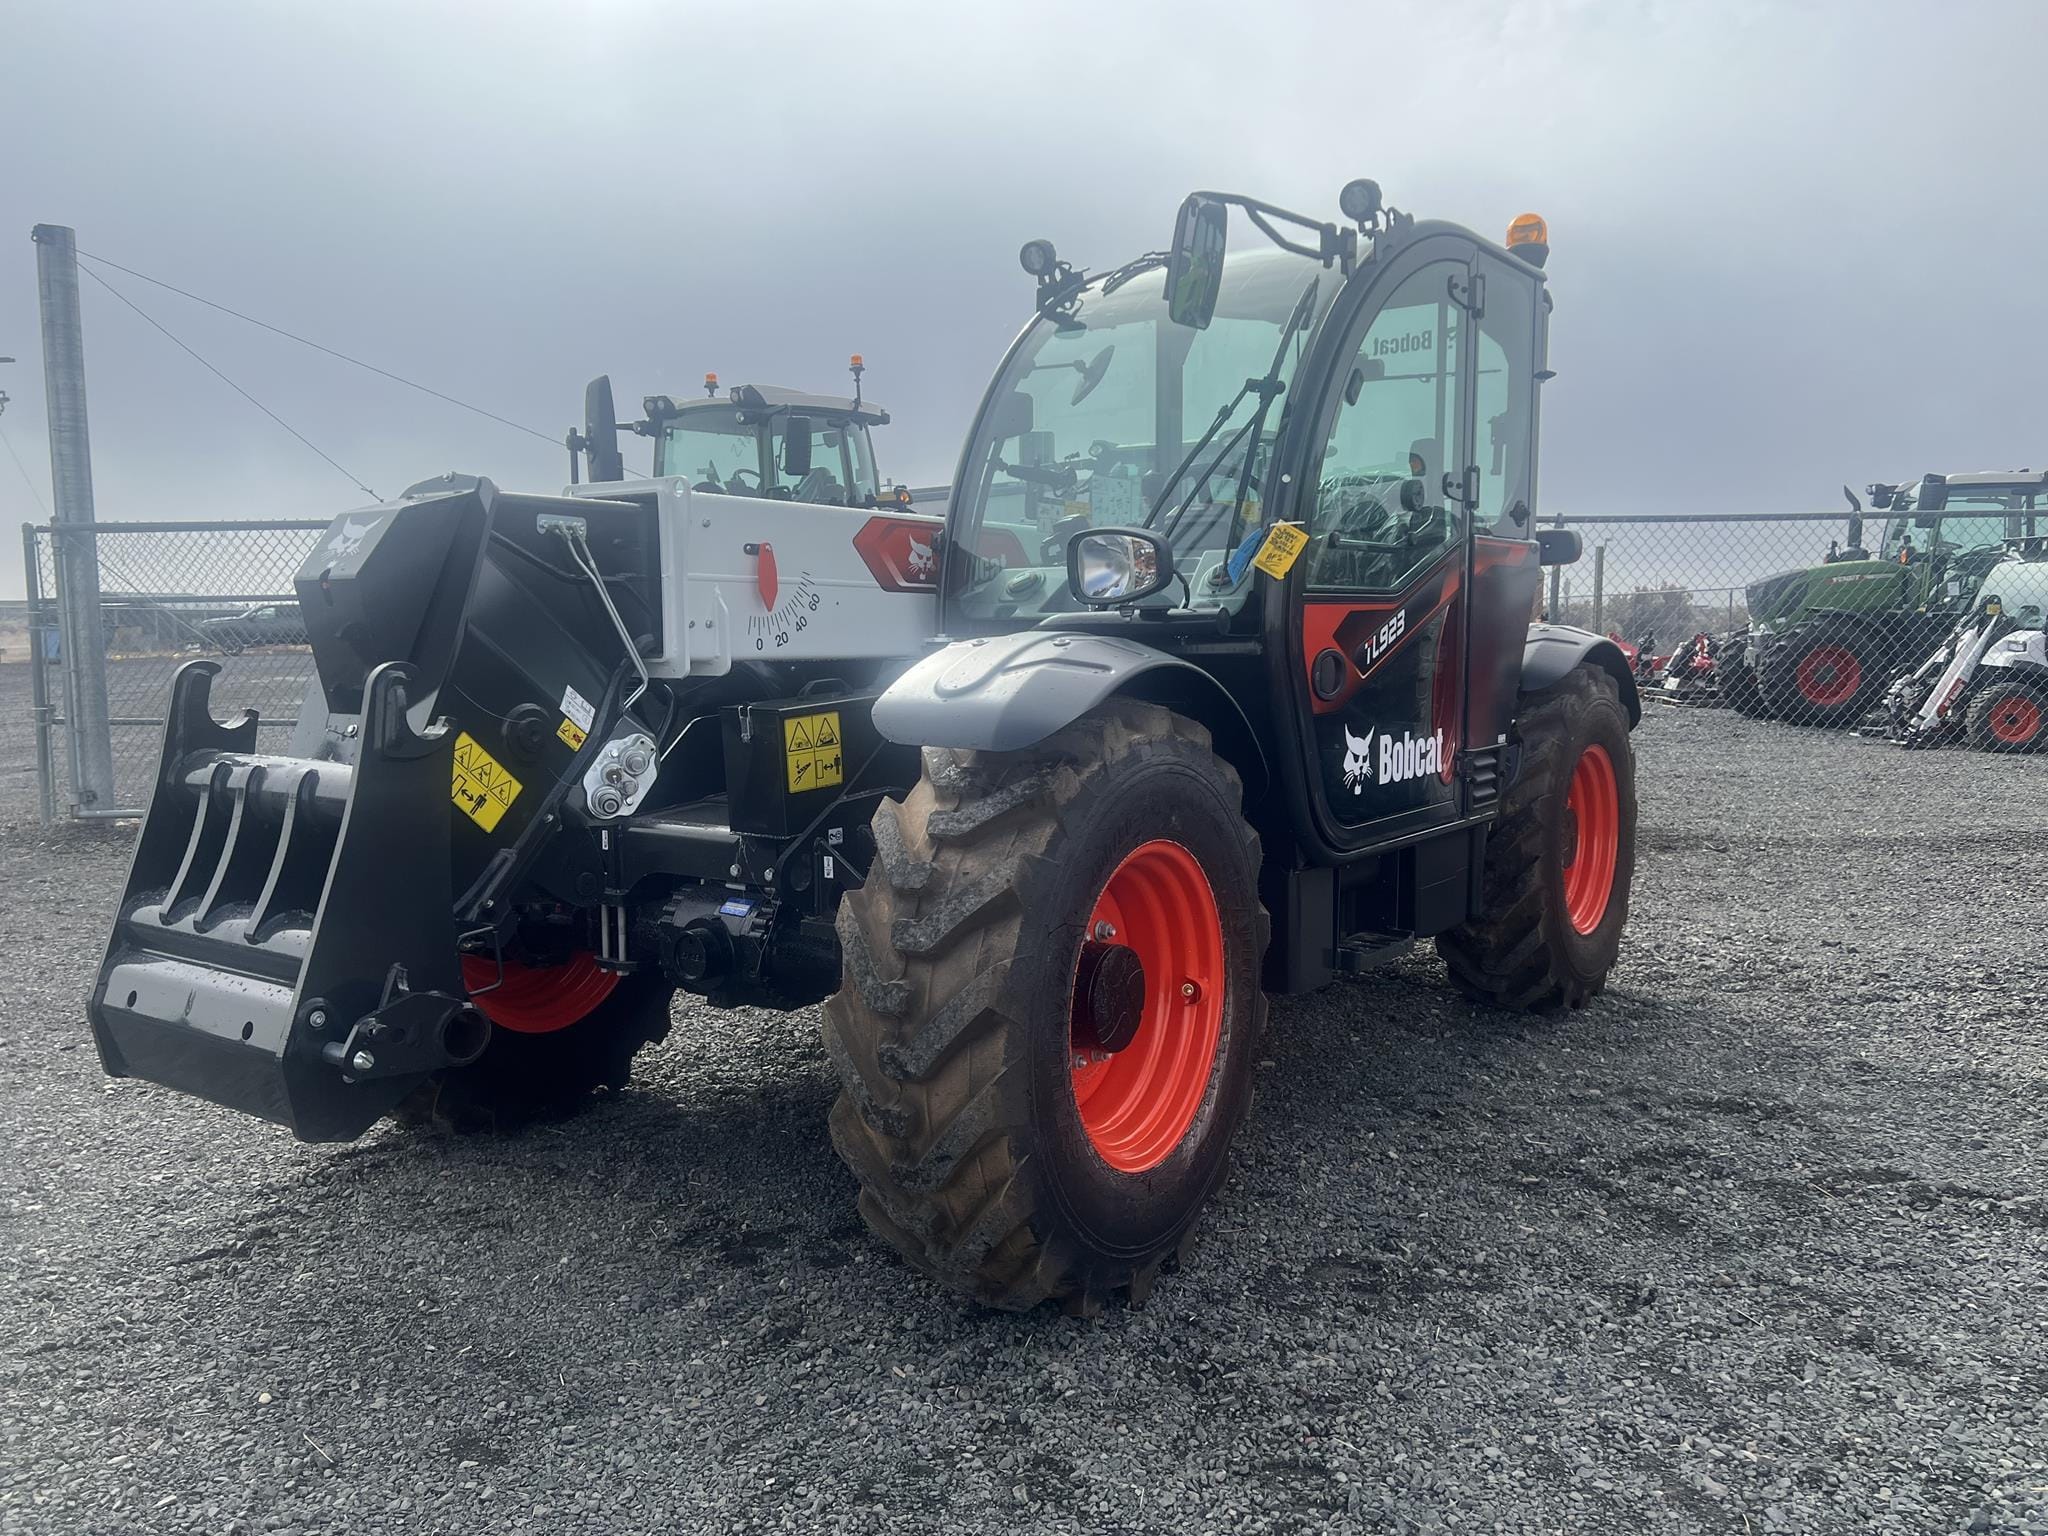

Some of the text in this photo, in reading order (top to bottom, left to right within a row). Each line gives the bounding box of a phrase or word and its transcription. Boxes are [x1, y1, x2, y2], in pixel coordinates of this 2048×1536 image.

[756, 593, 820, 651] 0 20 40 60
[1378, 727, 1444, 785] Bobcat
